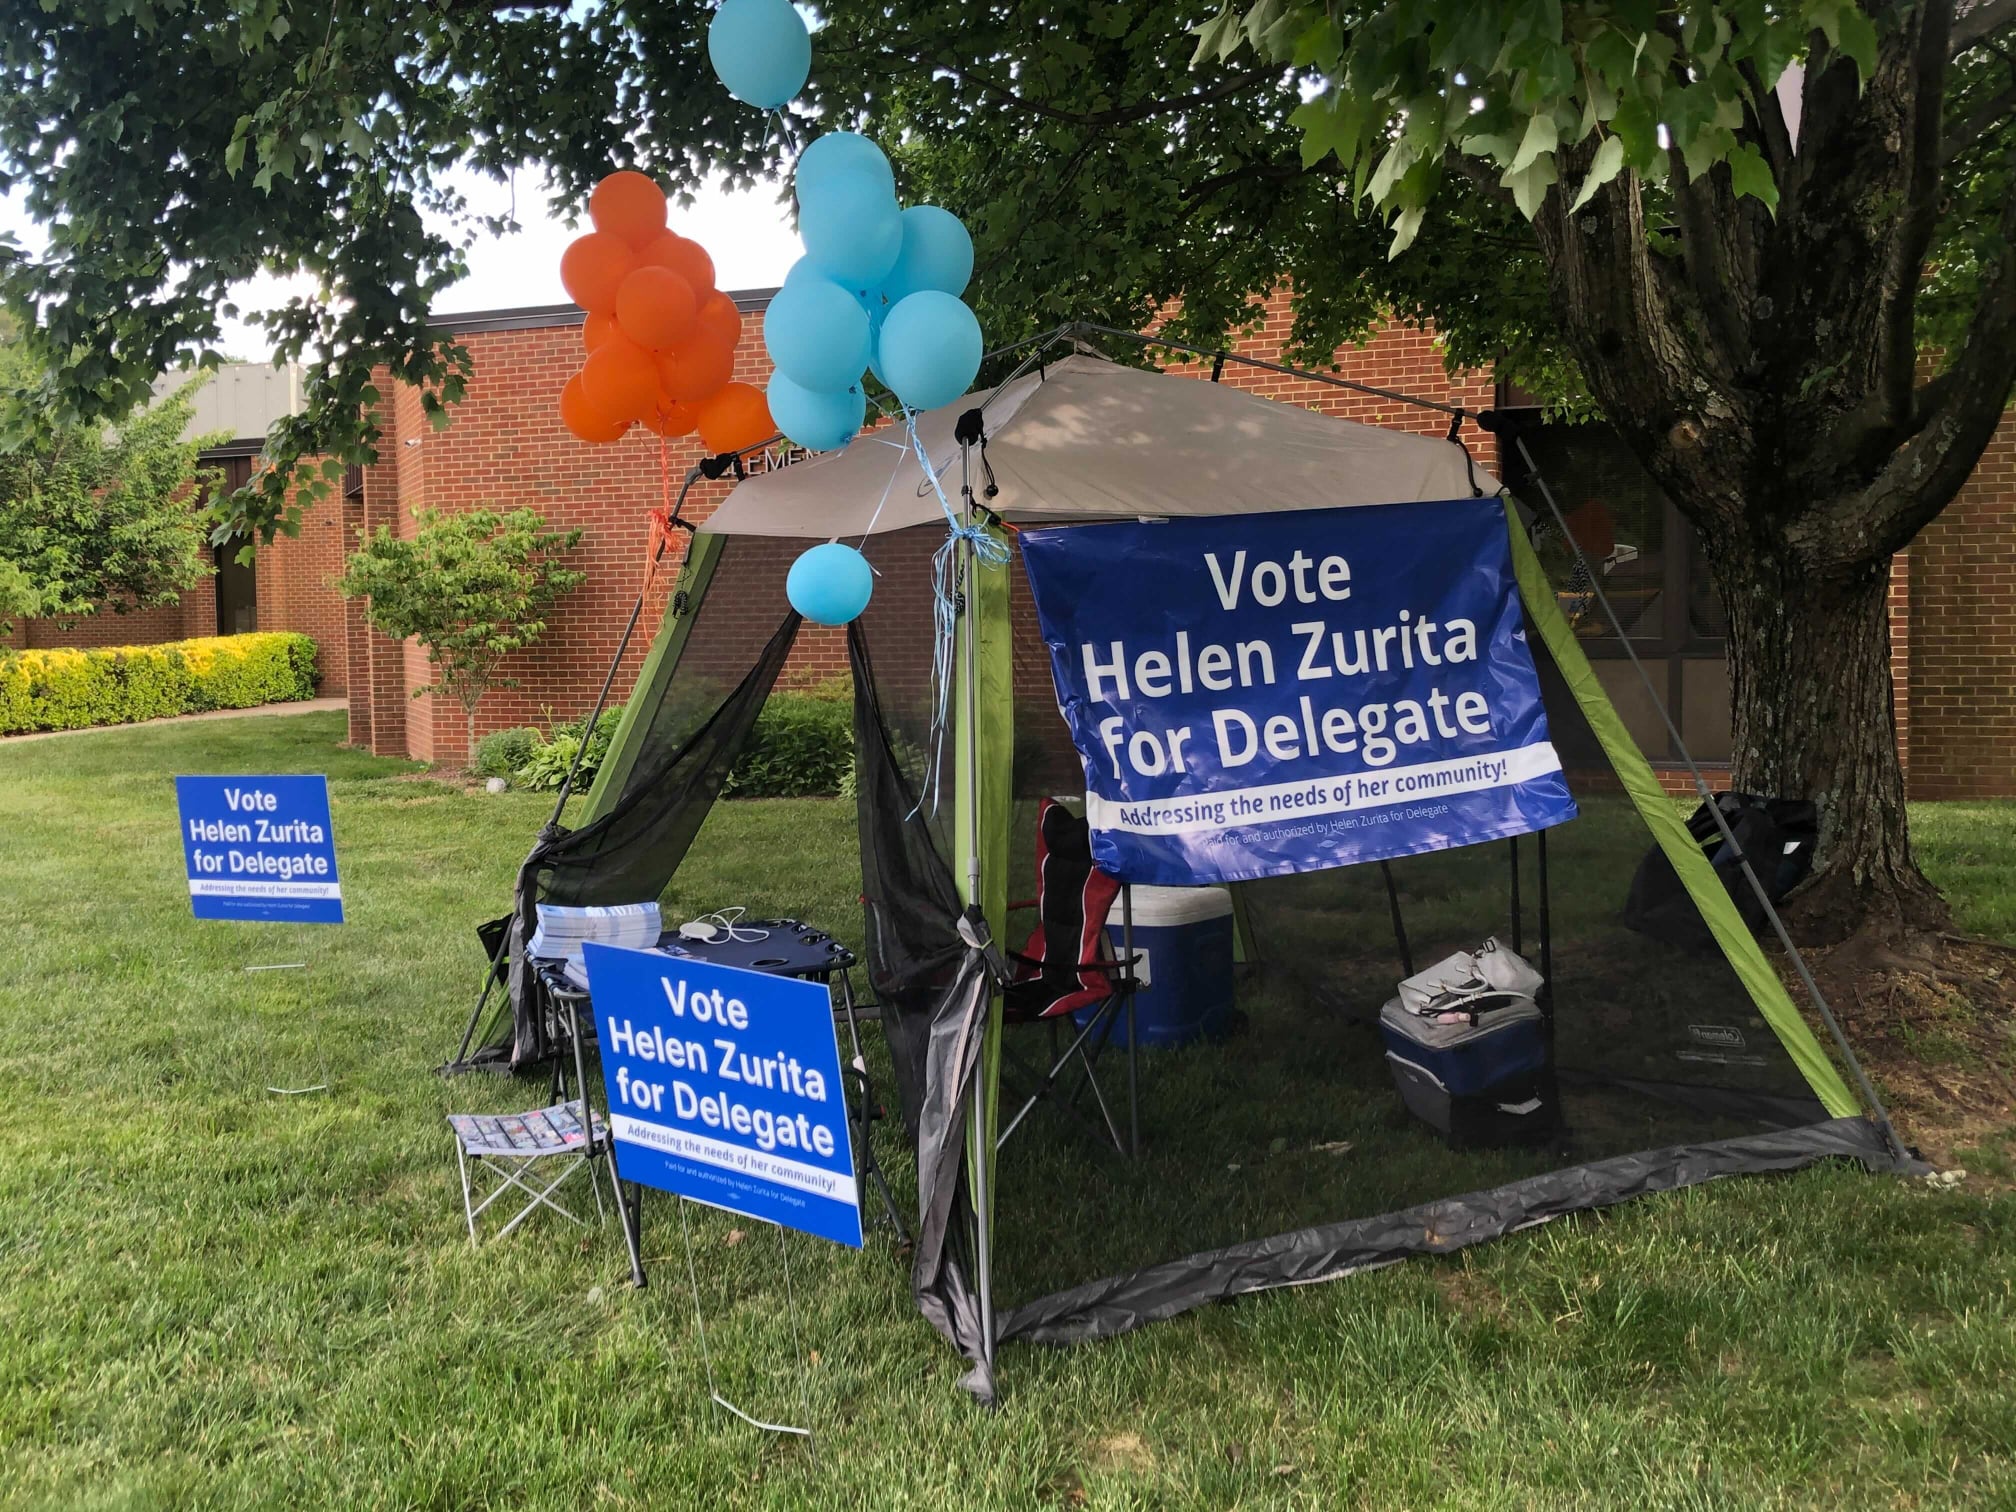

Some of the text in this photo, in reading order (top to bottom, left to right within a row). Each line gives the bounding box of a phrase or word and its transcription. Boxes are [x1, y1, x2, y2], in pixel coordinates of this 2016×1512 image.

[1204, 549, 1351, 611] Vote
[1081, 609, 1477, 703] Helen Zurita
[1099, 688, 1491, 780] for Delegate
[224, 788, 277, 812] Vote
[1120, 758, 1508, 826] Addressing the needs of her community!
[189, 819, 323, 843] Helen Zurita
[1225, 835, 1240, 846] for
[1243, 832, 1260, 845] and
[1263, 823, 1315, 842] authorized
[1316, 824, 1328, 836] by
[1330, 817, 1359, 832] Helen
[1361, 812, 1389, 826] Zurita
[1390, 810, 1404, 823] for
[1406, 804, 1449, 820] Delegate
[193, 849, 328, 880] for Delegate
[200, 883, 329, 897] Addressing the needs of her community!
[661, 976, 748, 1030] Vote
[608, 1016, 827, 1103] Helen Zurita
[616, 1066, 834, 1158] for Delegate
[628, 1123, 836, 1193] Addressing the needs of her community!
[728, 1177, 735, 1188] by
[736, 1180, 752, 1191] Helen
